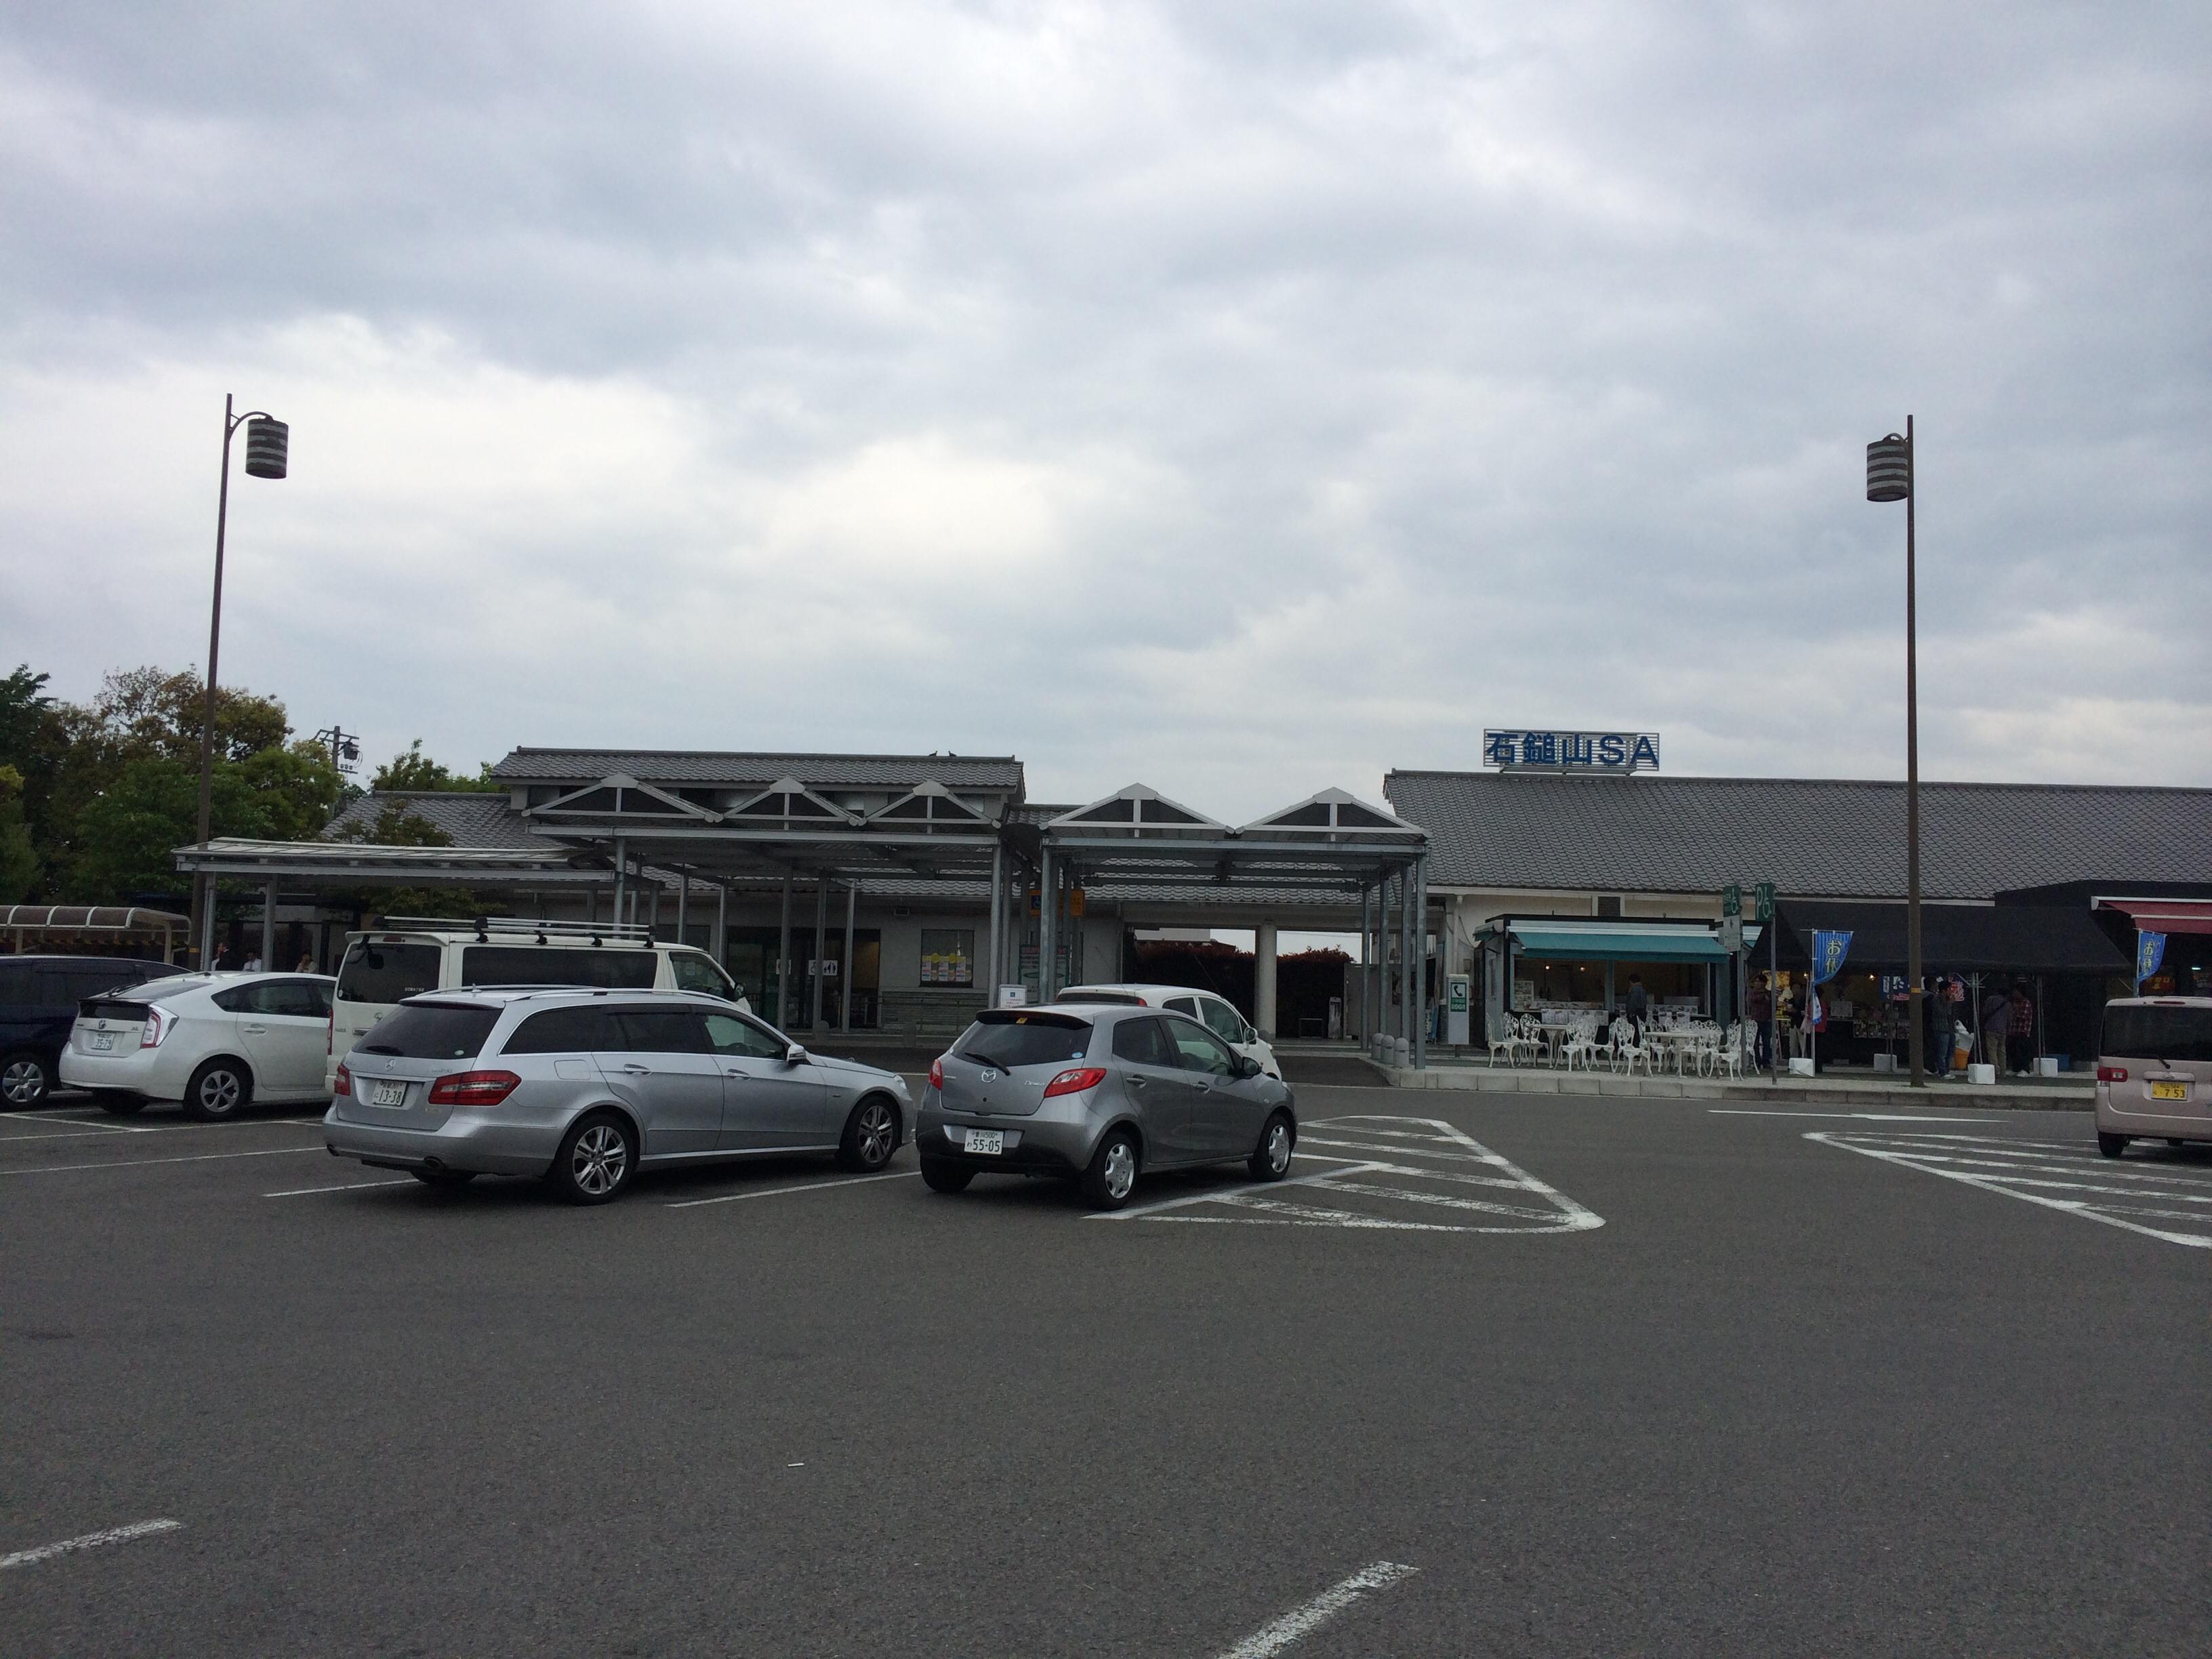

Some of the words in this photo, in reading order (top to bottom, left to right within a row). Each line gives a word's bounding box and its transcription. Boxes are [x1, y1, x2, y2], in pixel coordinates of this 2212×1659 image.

[1486, 731, 1658, 766] 石鎚山SA
[1757, 886, 1763, 919] P
[972, 1139, 1001, 1152] 55-05
